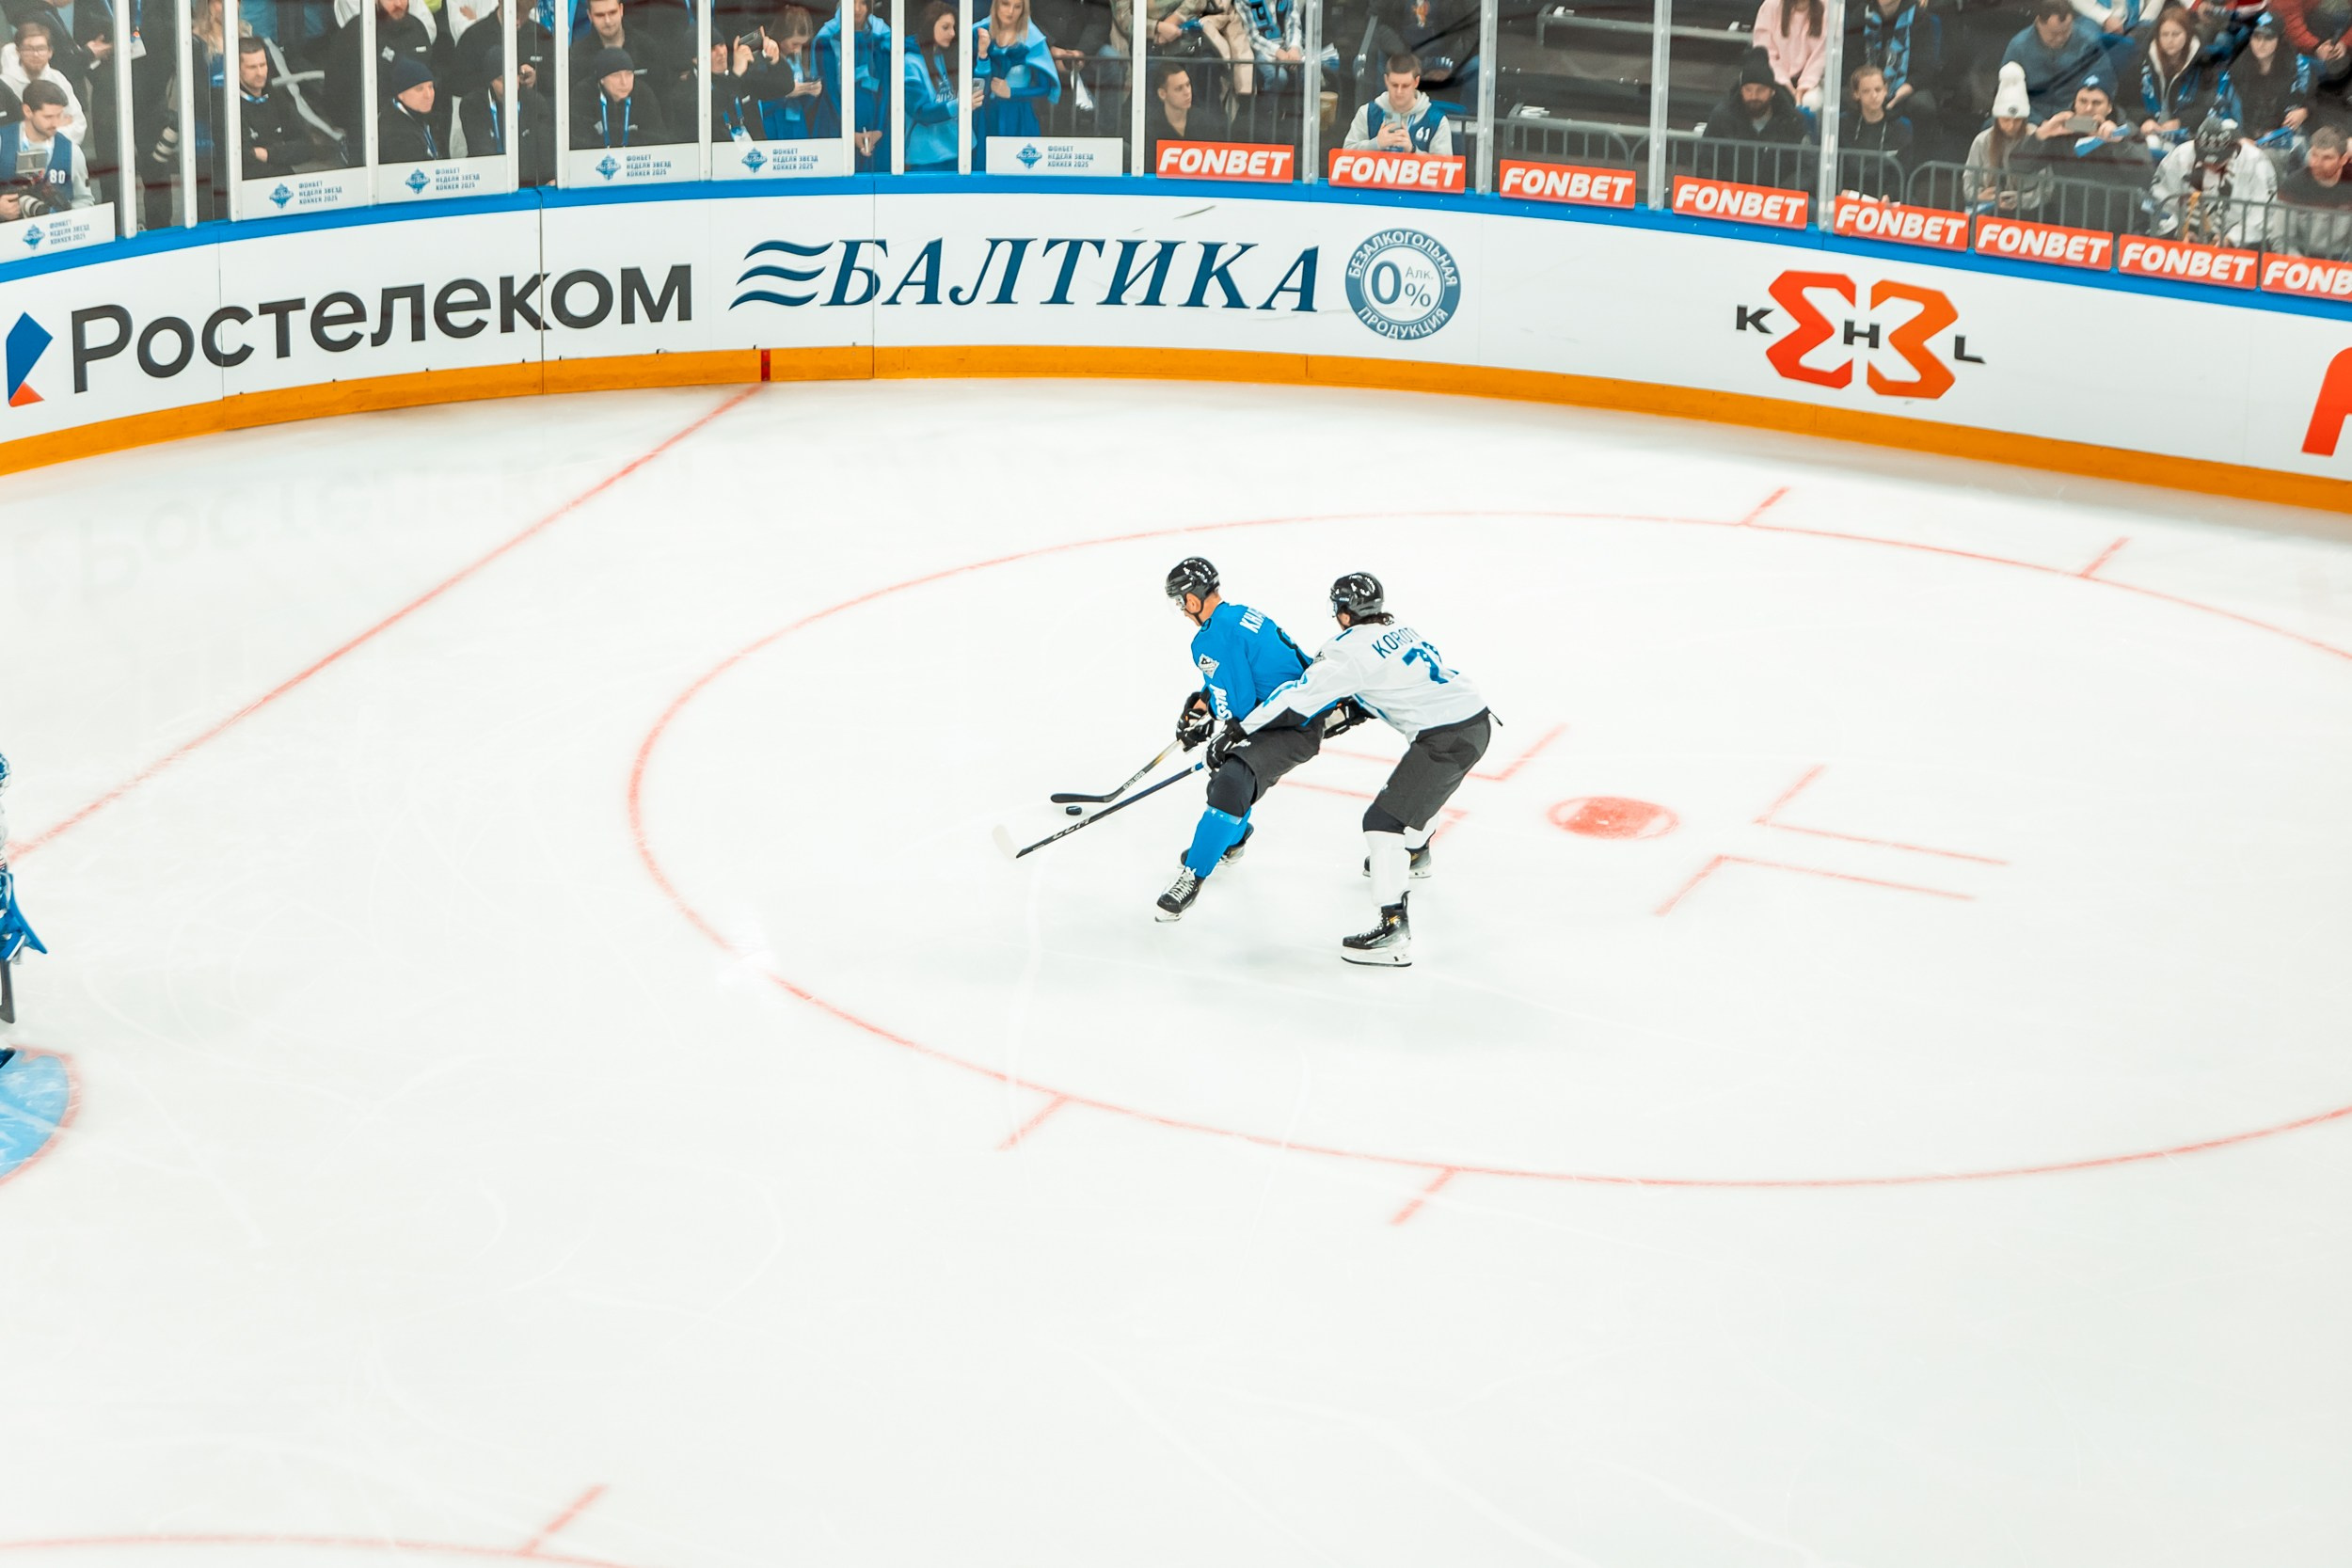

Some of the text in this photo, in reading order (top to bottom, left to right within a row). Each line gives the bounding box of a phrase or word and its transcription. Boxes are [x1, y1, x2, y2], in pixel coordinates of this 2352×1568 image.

[1415, 126, 1430, 141] 61
[1159, 148, 1291, 177] FONBET
[1331, 155, 1463, 187] FONBET
[1502, 167, 1633, 201] FONBET
[1675, 183, 1805, 223] FONBET
[1836, 204, 1968, 245] FONBET
[1977, 223, 2111, 263] FONBET
[819, 237, 1320, 312] БАЛТИКА
[1347, 230, 1458, 287] БЕЗАЛКОГОЛЬНАЯ
[2120, 241, 2255, 282] FONBET
[71, 263, 692, 394] Ростелеком
[1357, 306, 1449, 340] ПРОДУКЦИЯ
